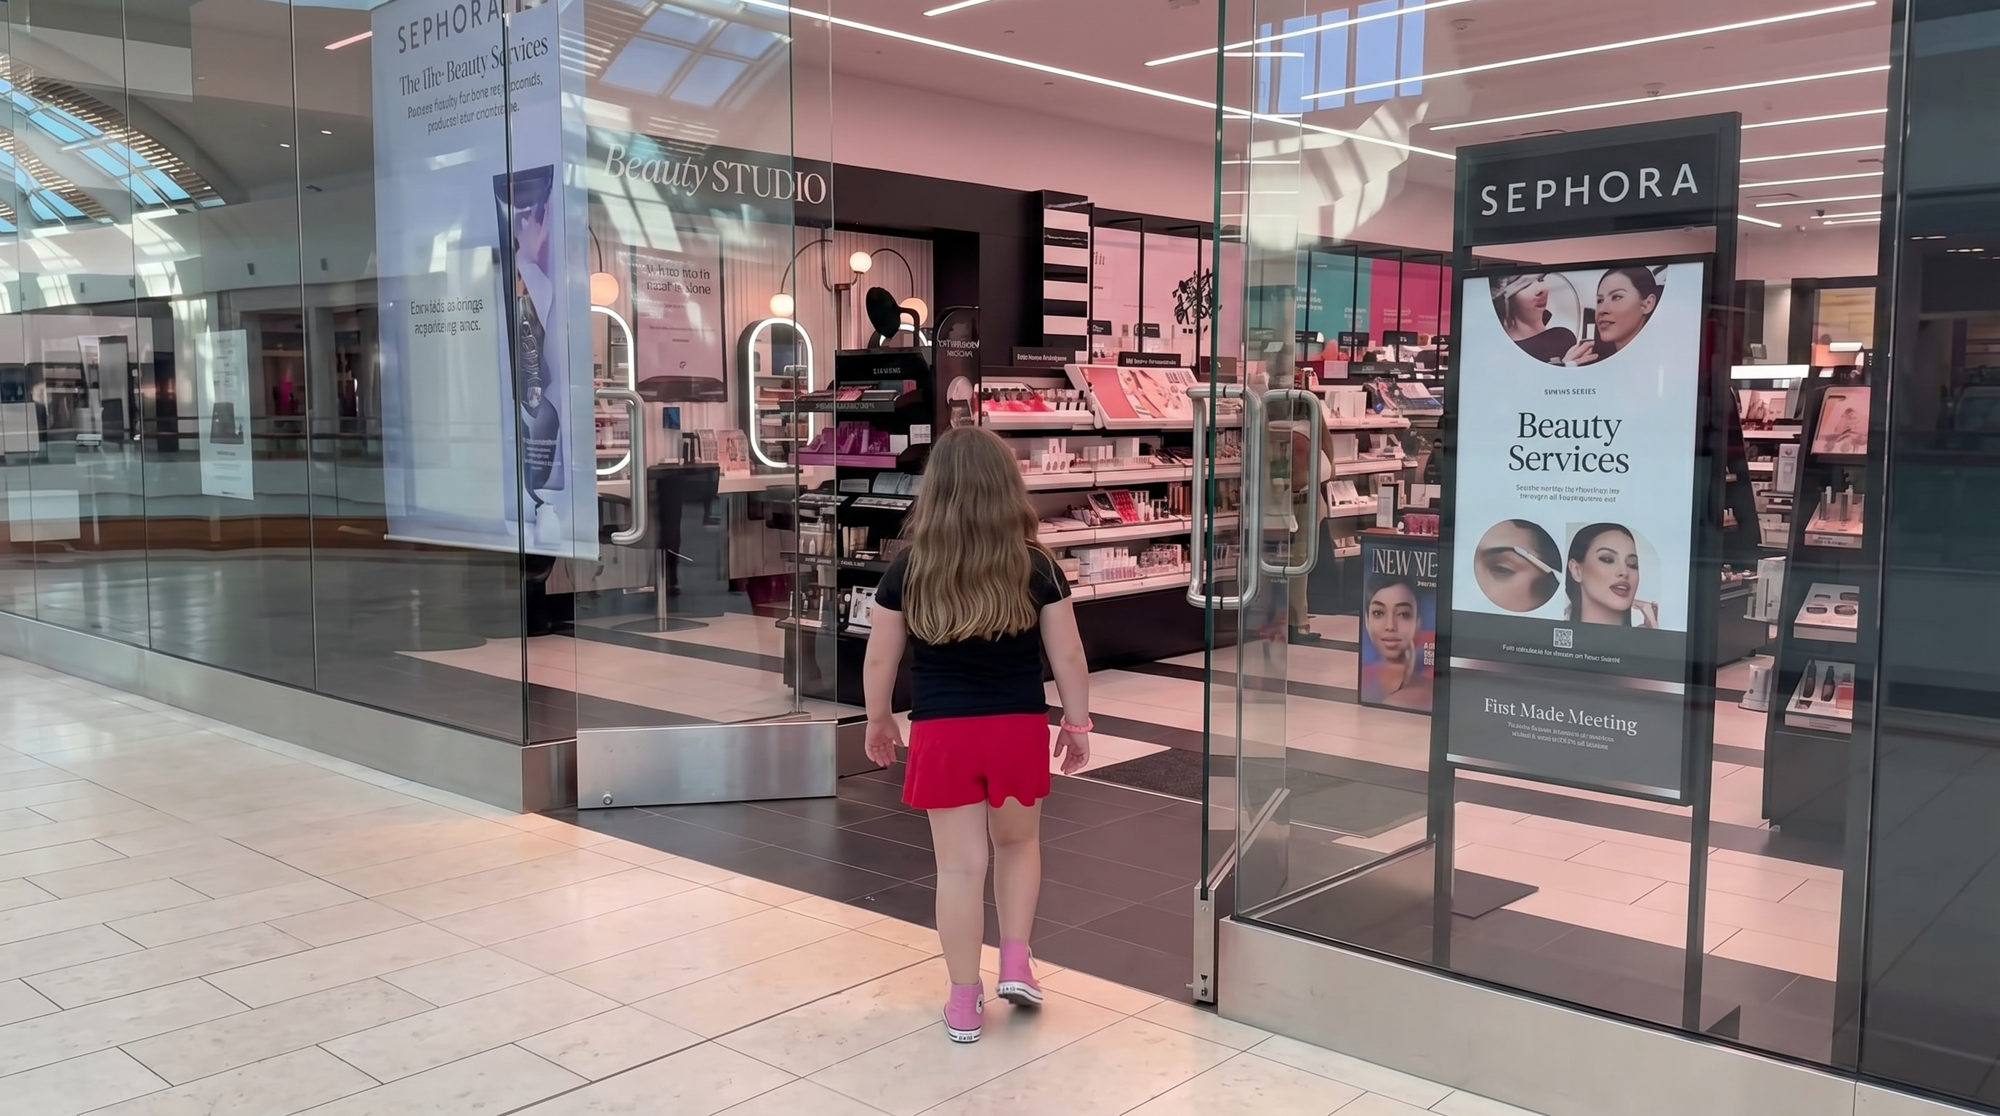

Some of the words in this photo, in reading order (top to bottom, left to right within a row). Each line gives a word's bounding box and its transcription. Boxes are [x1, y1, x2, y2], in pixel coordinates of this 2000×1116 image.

[398, 0, 500, 54] SEPHORA
[399, 74, 420, 96] The
[447, 53, 488, 83] Beauty
[601, 143, 708, 196] Beauty
[712, 159, 827, 205] STUDIO
[1481, 163, 1698, 216] SEPHORA
[1516, 412, 1623, 447] Beauty
[1508, 445, 1630, 474] Services
[1484, 697, 1516, 716] First
[1520, 702, 1565, 722] Made
[1567, 708, 1638, 737] Meeting
